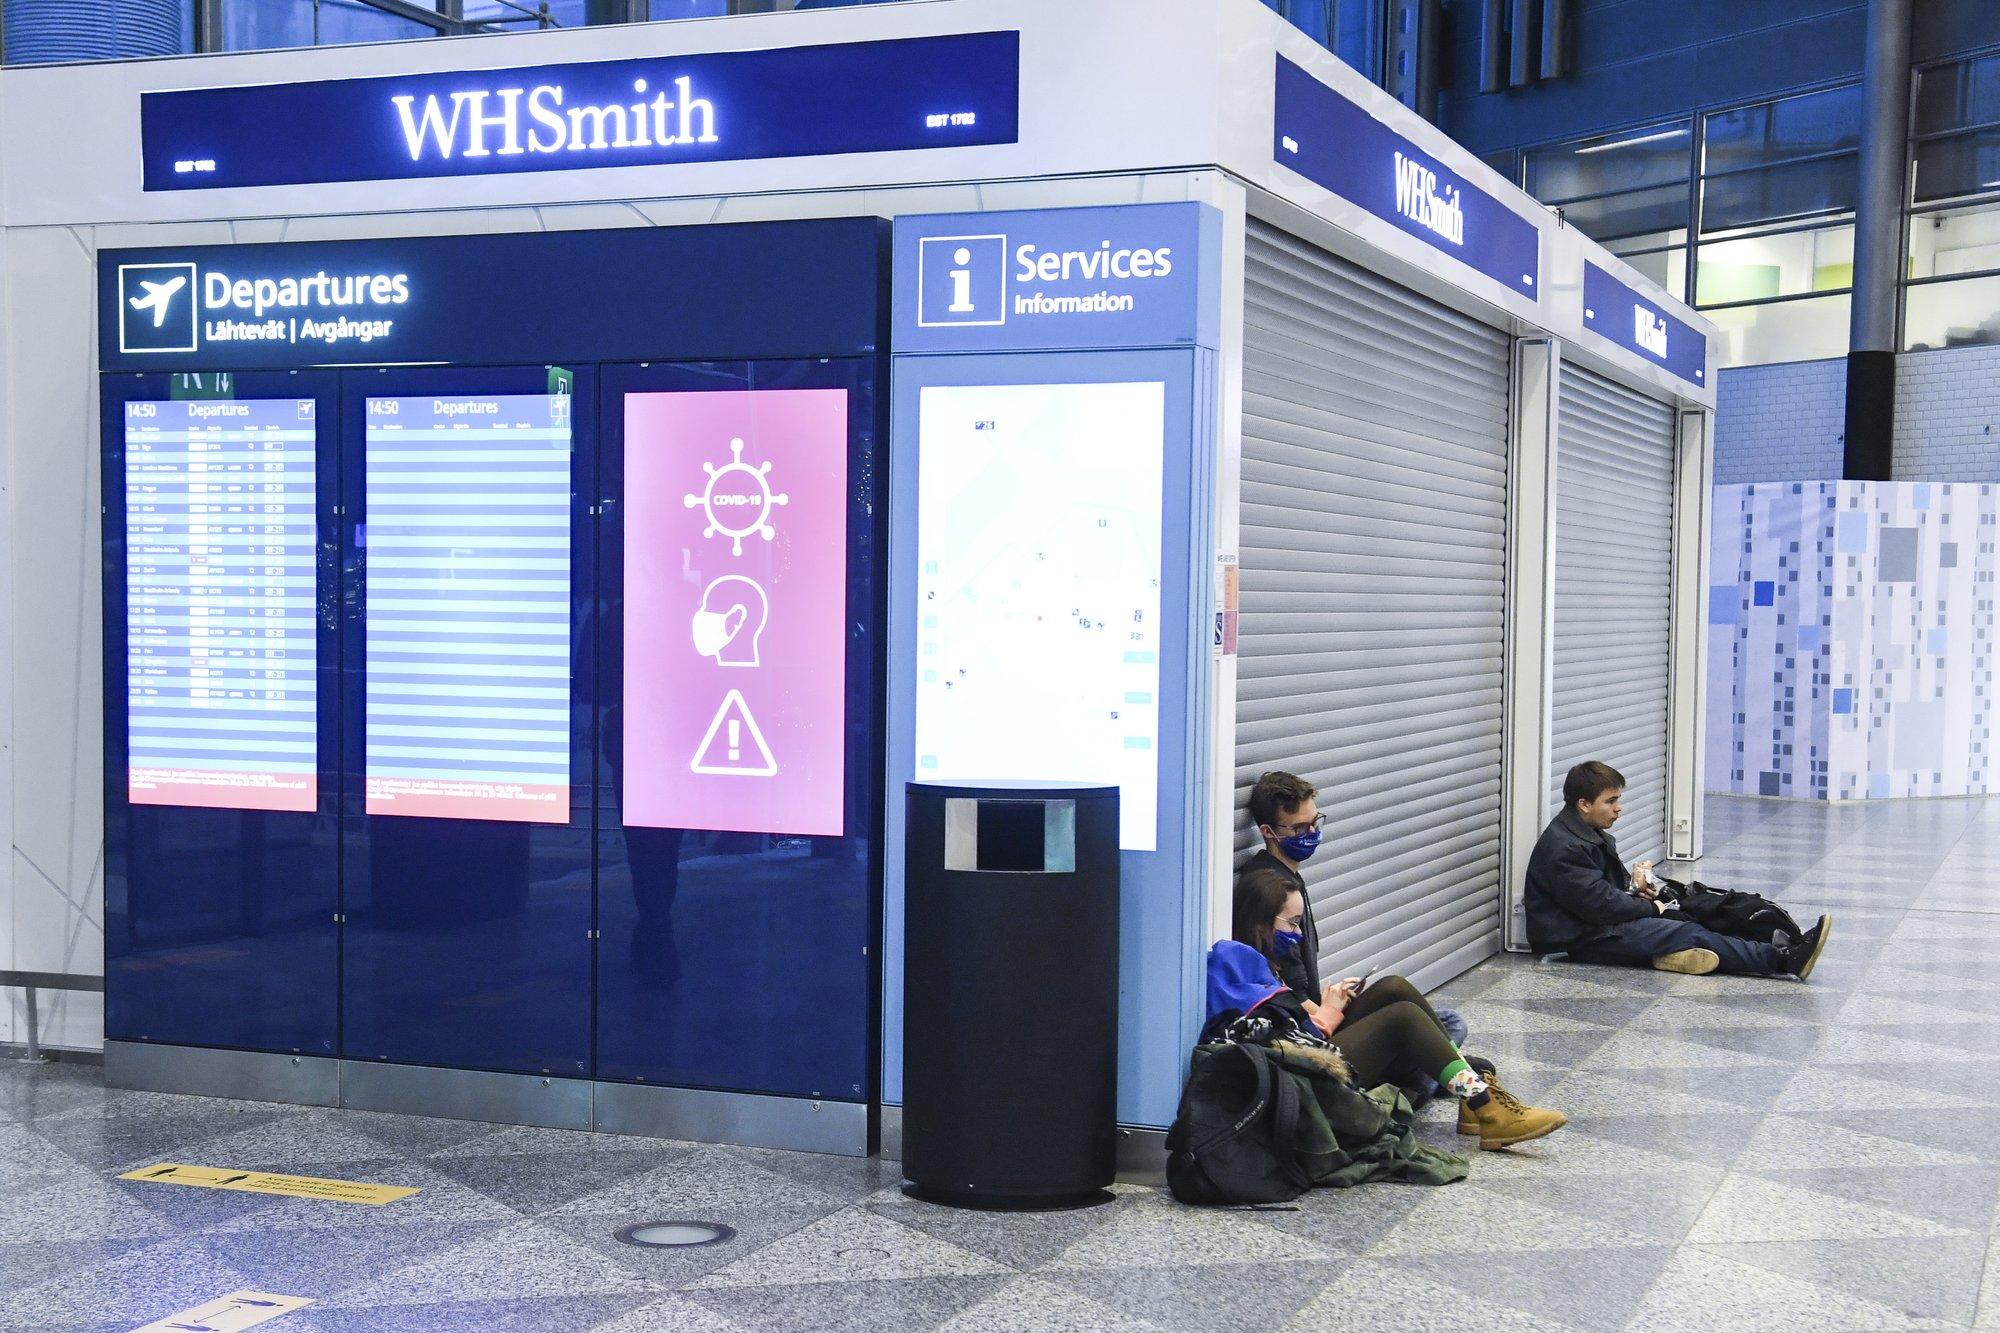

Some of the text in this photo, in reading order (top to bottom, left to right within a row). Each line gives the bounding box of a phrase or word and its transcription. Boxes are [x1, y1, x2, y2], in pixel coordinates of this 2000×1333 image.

[393, 76, 718, 161] WHSmith
[1394, 150, 1464, 246] WHSmith
[1015, 239, 1172, 282] Services
[204, 271, 409, 315] Departures
[1014, 291, 1134, 316] Information
[205, 315, 393, 344] Lähtevät Avgångar
[127, 402, 250, 420] 14:50 Departures
[367, 399, 499, 418] 14:50 Departures
[713, 494, 761, 506] COVID-19
